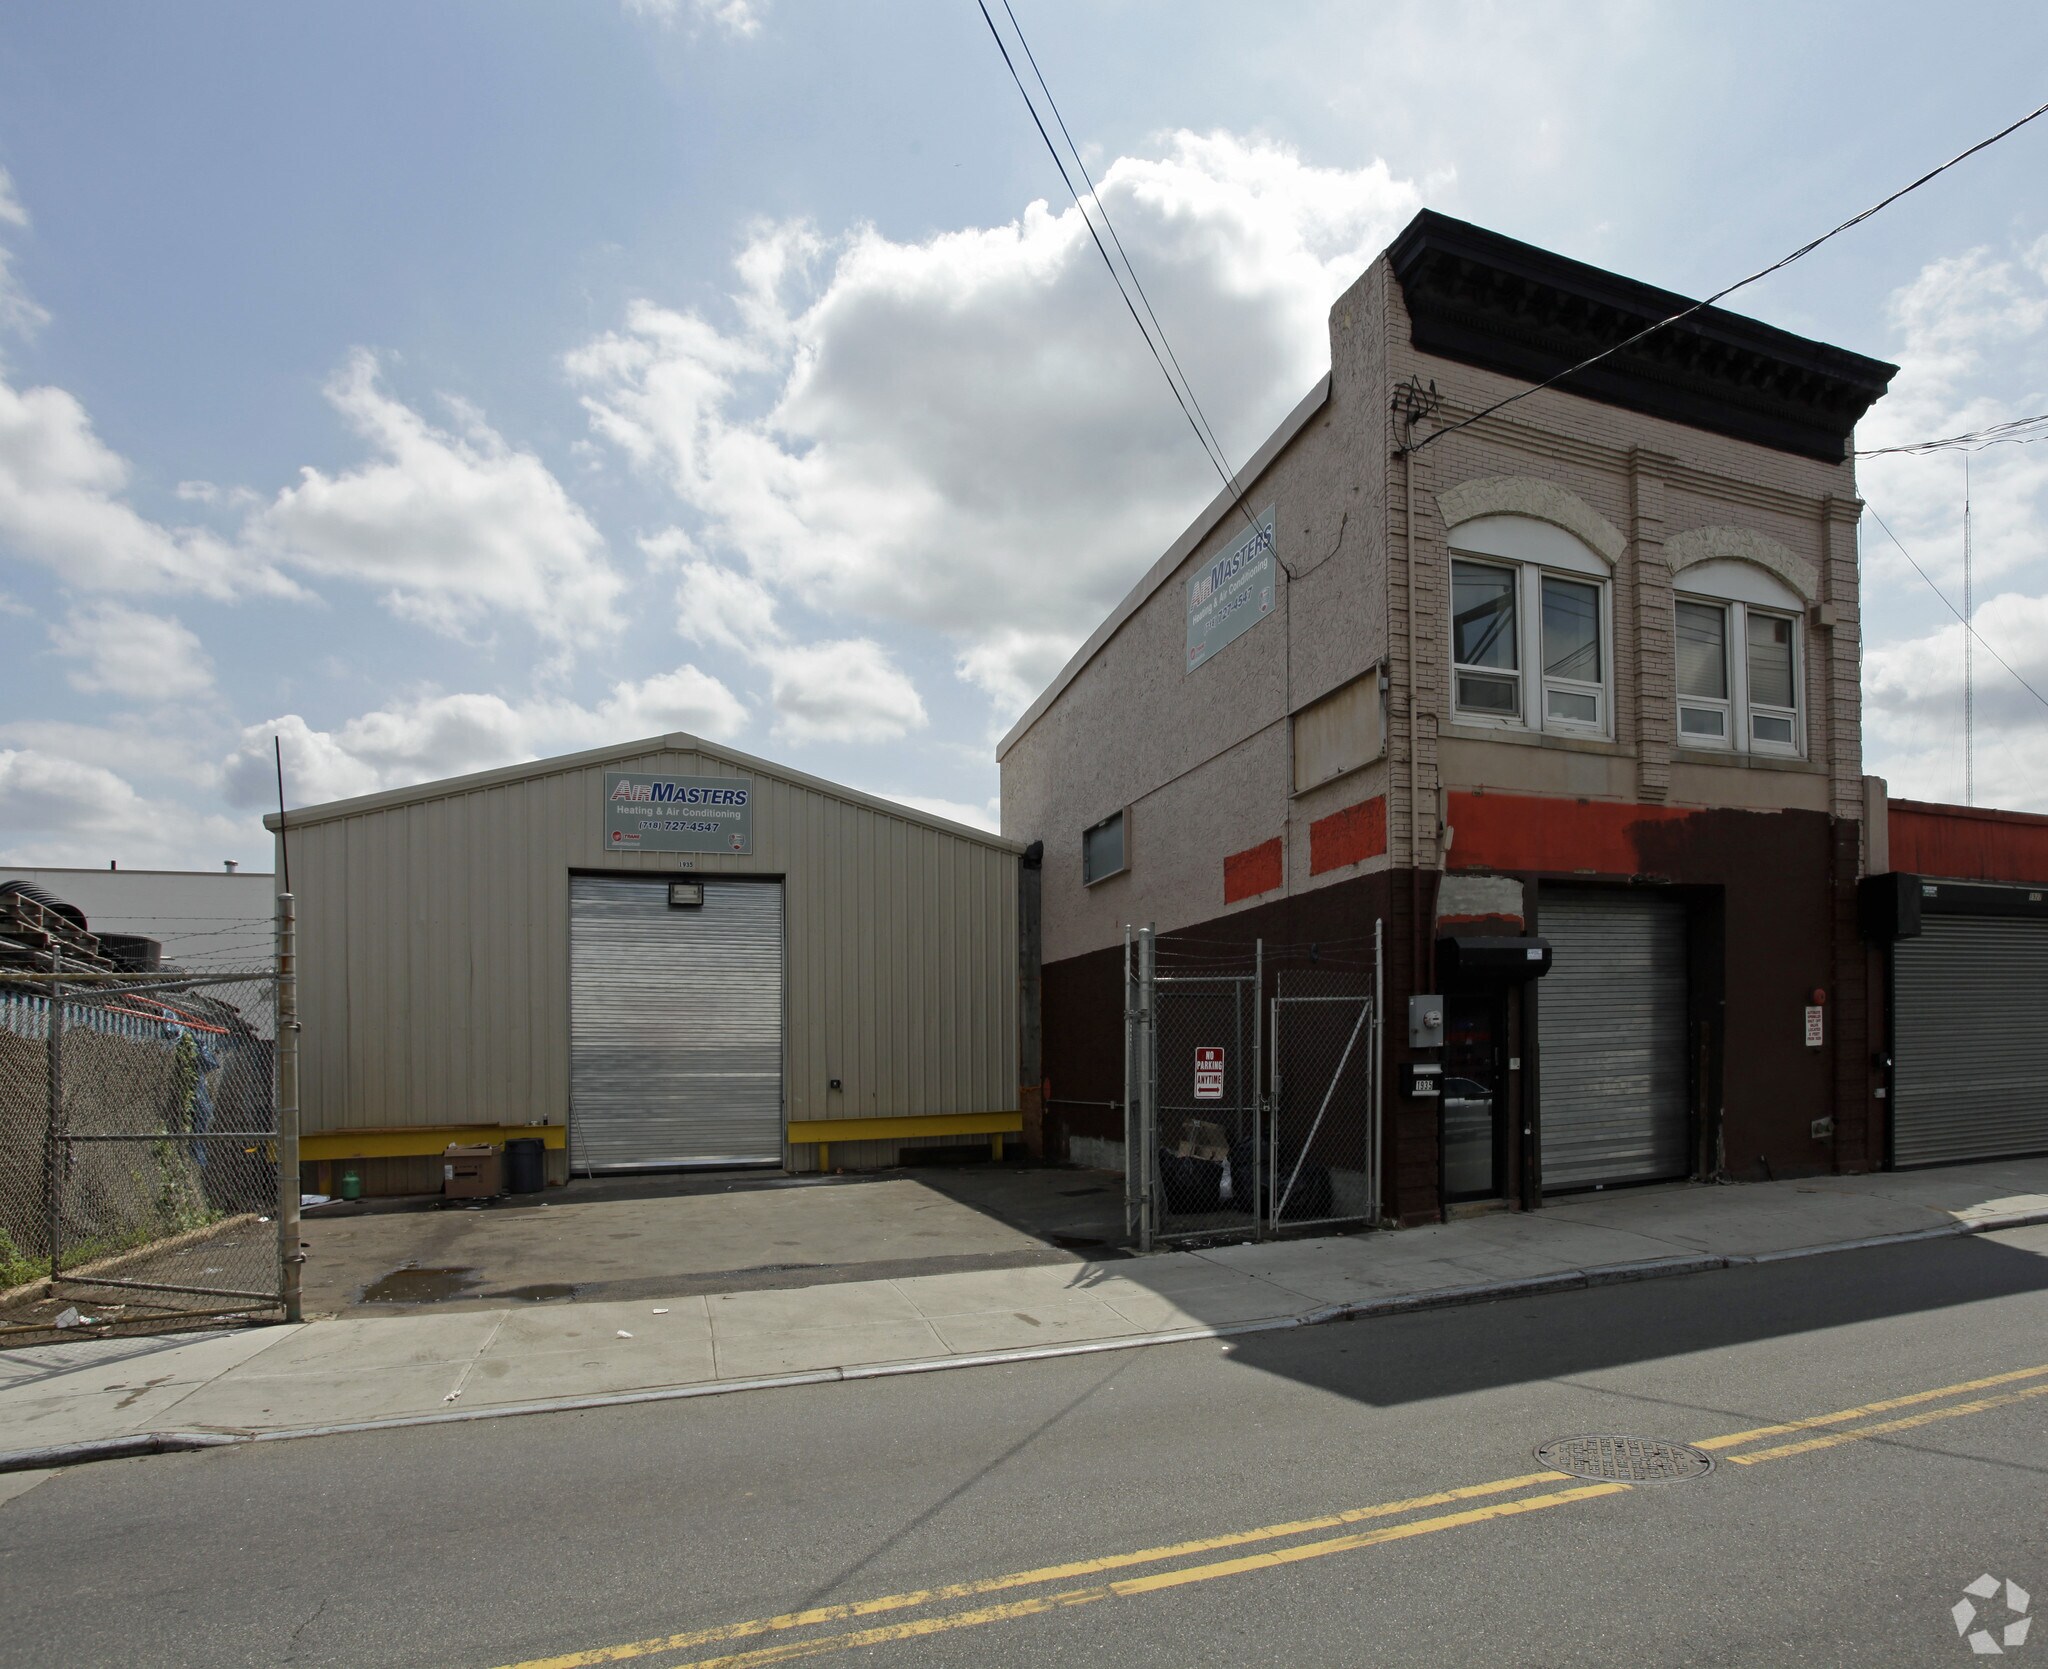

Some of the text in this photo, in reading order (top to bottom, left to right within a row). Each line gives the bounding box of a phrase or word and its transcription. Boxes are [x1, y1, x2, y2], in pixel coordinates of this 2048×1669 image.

[1192, 557, 1268, 625] Heating & Air Conditioning
[1217, 584, 1254, 624] 727-4547
[616, 805, 741, 820] Heating & Air Conditioning
[638, 821, 720, 832] (718) 727-4547
[1205, 1051, 1214, 1060] NO
[1196, 1060, 1223, 1070] PARKING
[1197, 1074, 1221, 1085] ANYTIME
[1416, 1080, 1433, 1090] 1935
